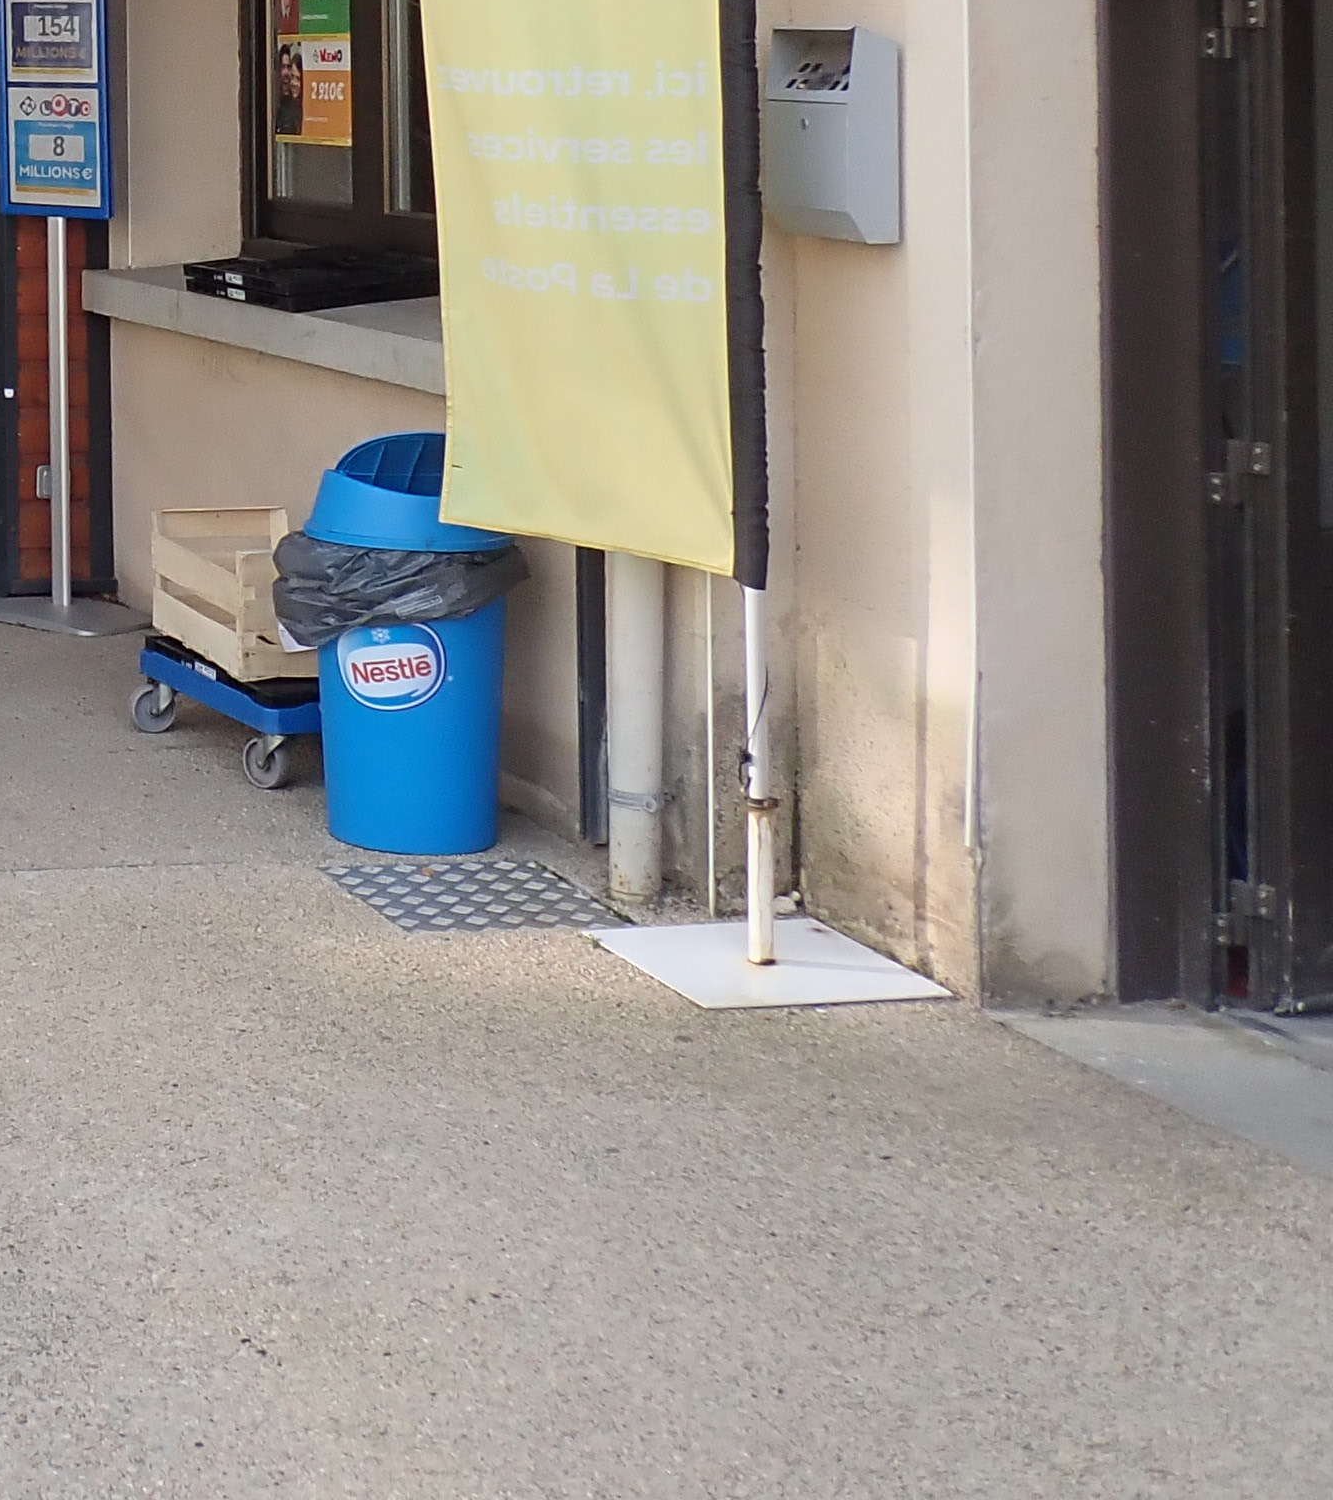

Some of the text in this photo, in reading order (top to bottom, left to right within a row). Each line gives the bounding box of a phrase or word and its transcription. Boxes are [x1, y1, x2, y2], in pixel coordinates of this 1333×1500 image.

[37, 16, 76, 37] 154
[16, 46, 76, 59] MILLIONS
[39, 94, 91, 117] LOTO
[53, 136, 65, 157] 8
[19, 164, 81, 179] MILLIONS
[351, 654, 432, 685] Nestlé
